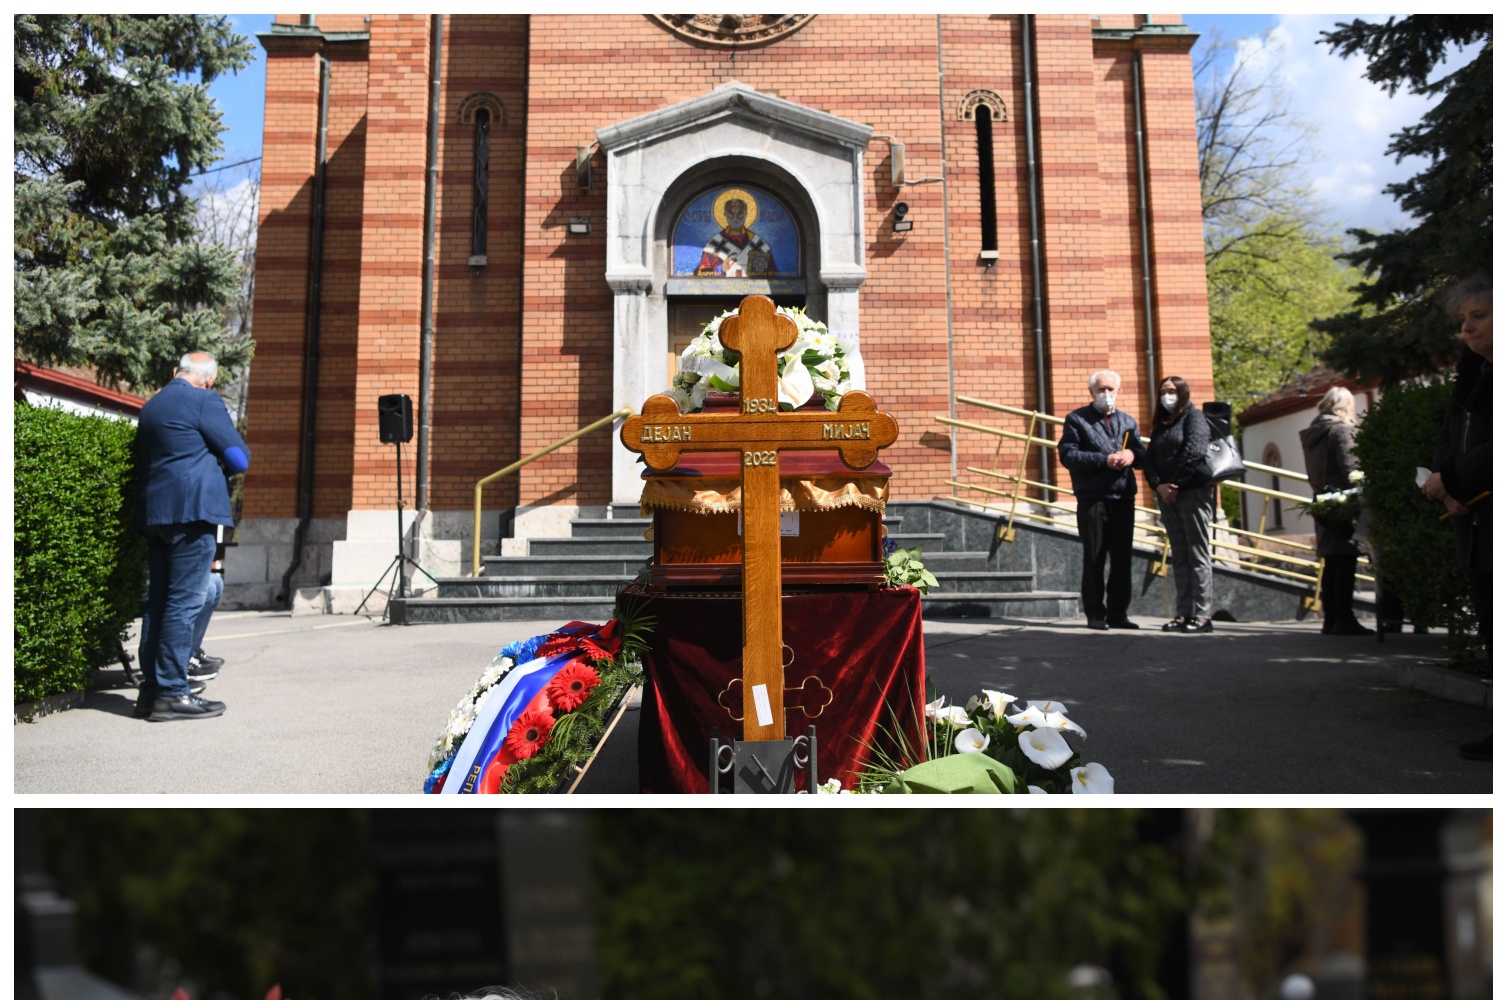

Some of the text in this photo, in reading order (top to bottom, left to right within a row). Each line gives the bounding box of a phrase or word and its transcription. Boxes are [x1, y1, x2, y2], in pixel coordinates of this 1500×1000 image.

[743, 397, 777, 414] 1934
[640, 422, 871, 443] ДЕЈАН МИЈАЧ
[744, 450, 777, 467] 2022
[463, 766, 481, 793] РЕП
